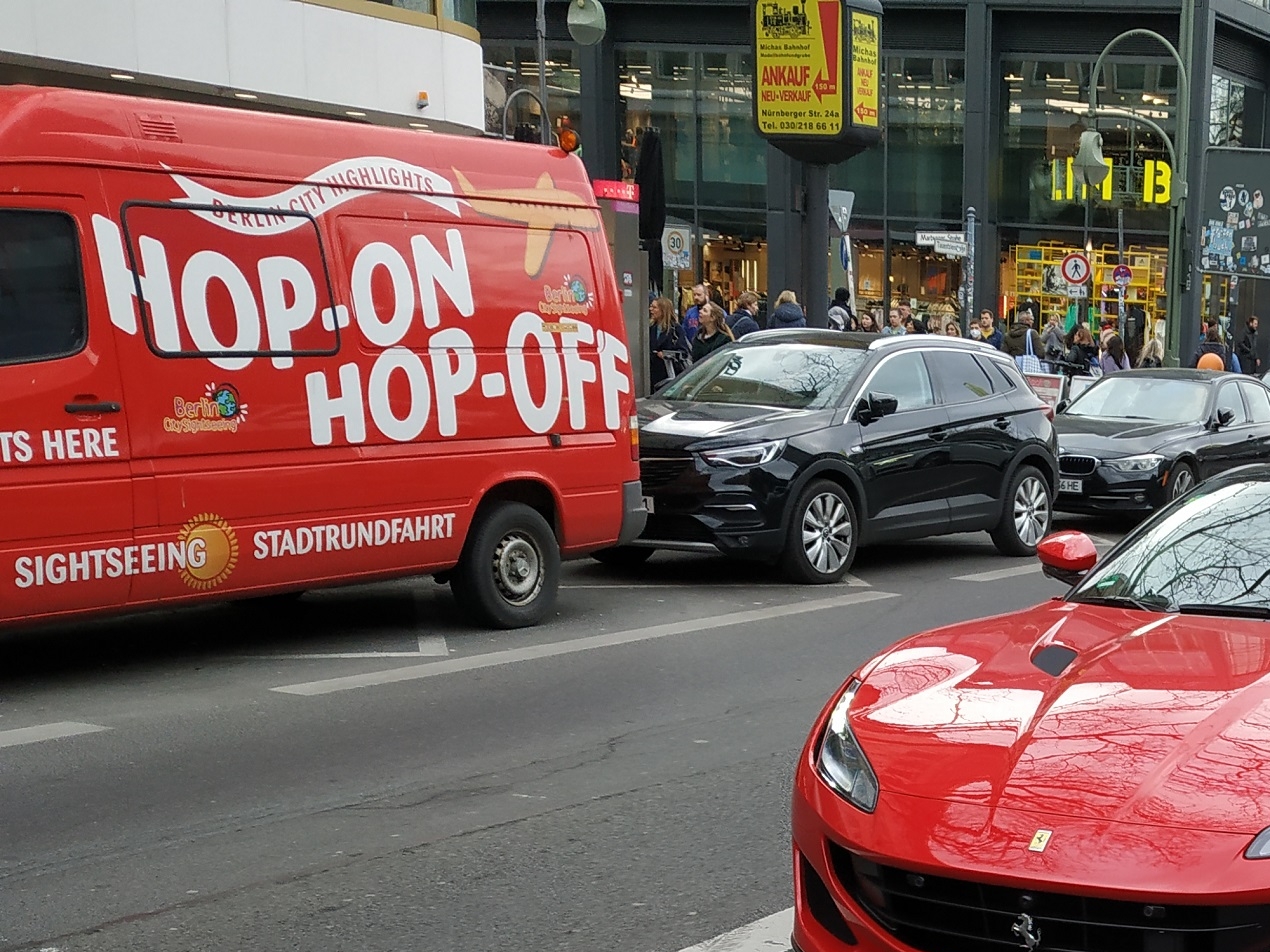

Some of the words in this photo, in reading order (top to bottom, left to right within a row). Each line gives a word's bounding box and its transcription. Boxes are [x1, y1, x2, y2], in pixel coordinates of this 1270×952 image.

[853, 45, 877, 57] Michas
[853, 54, 877, 65] Bahnhof
[761, 66, 811, 87] ANKAUF
[857, 67, 873, 78] ANKAUF
[857, 87, 873, 97] VERKAUF
[761, 109, 806, 118] Nürnberger
[825, 110, 839, 118] 24a
[856, 107, 868, 115] 150
[761, 121, 777, 129] Tel.
[816, 122, 827, 130] 66
[829, 123, 840, 131] 11
[211, 198, 288, 228] BERLIN
[288, 187, 327, 214] CITY
[325, 166, 434, 198] HIGHLIGHTS
[670, 237, 681, 249] 30
[92, 213, 475, 370] HOP-ON
[304, 311, 630, 447] HOP-OFF
[174, 396, 220, 418] Berlin
[42, 427, 120, 460] HERE
[253, 512, 457, 560] STADTRUNDFAHRT
[14, 538, 207, 588] SIGHTSEEING
